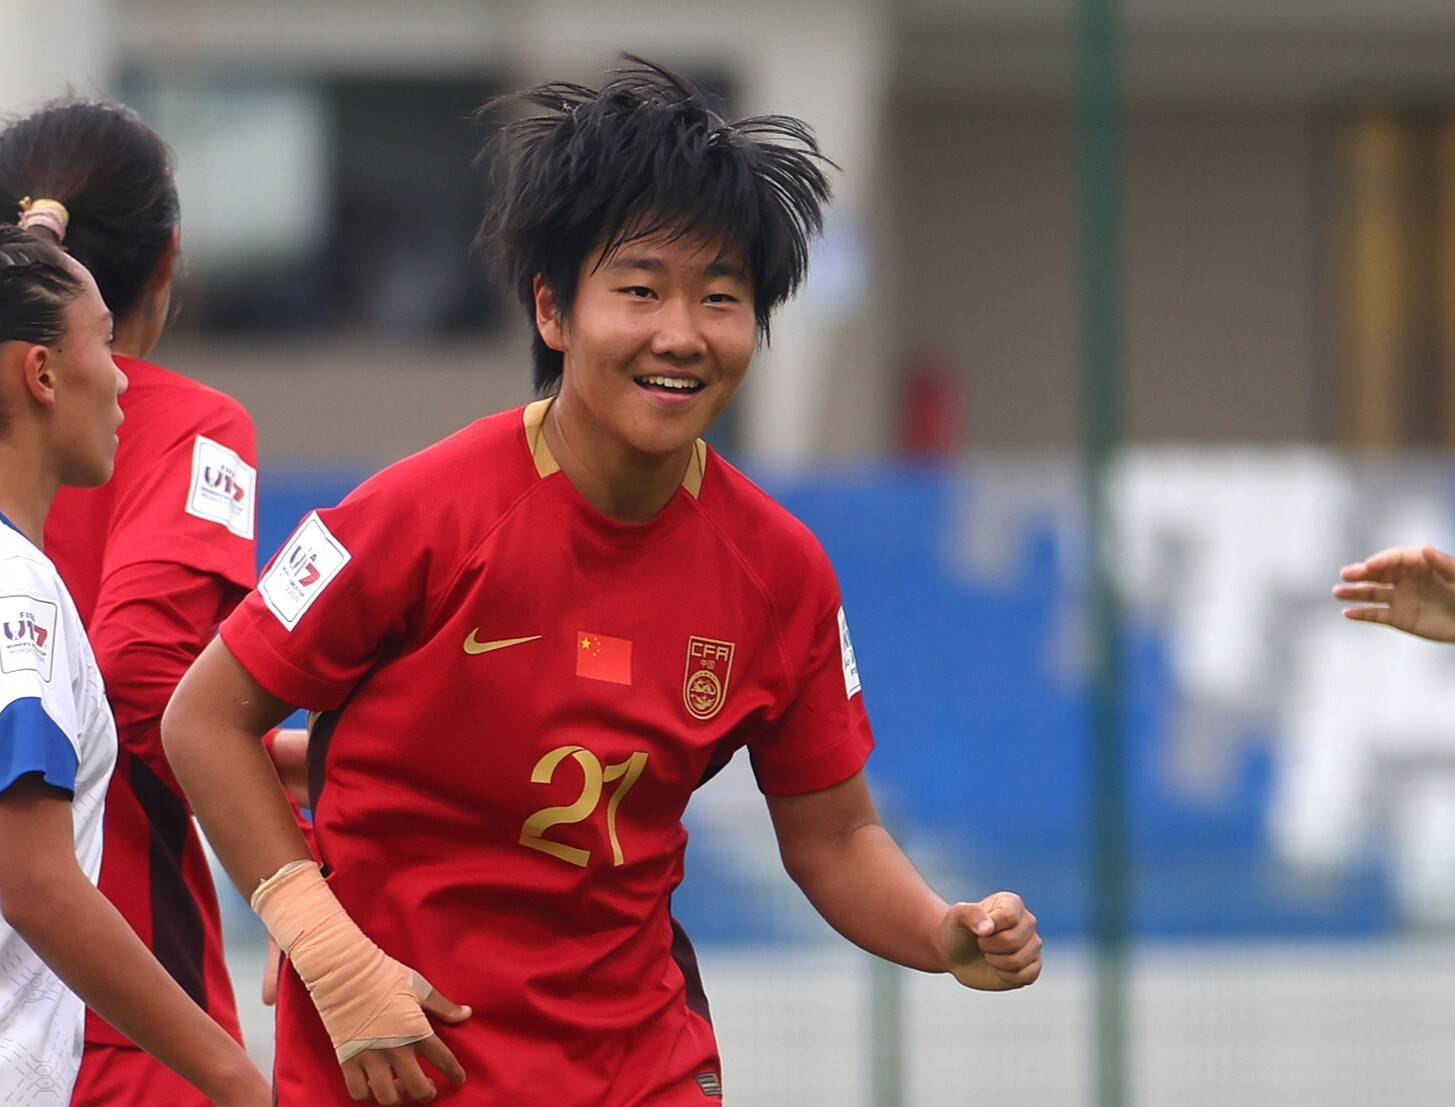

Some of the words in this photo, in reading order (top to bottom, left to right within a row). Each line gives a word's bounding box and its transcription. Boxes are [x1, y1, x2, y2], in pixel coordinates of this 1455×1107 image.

[3, 620, 48, 648] U17
[691, 642, 730, 661] CFA
[519, 745, 648, 867] 21
